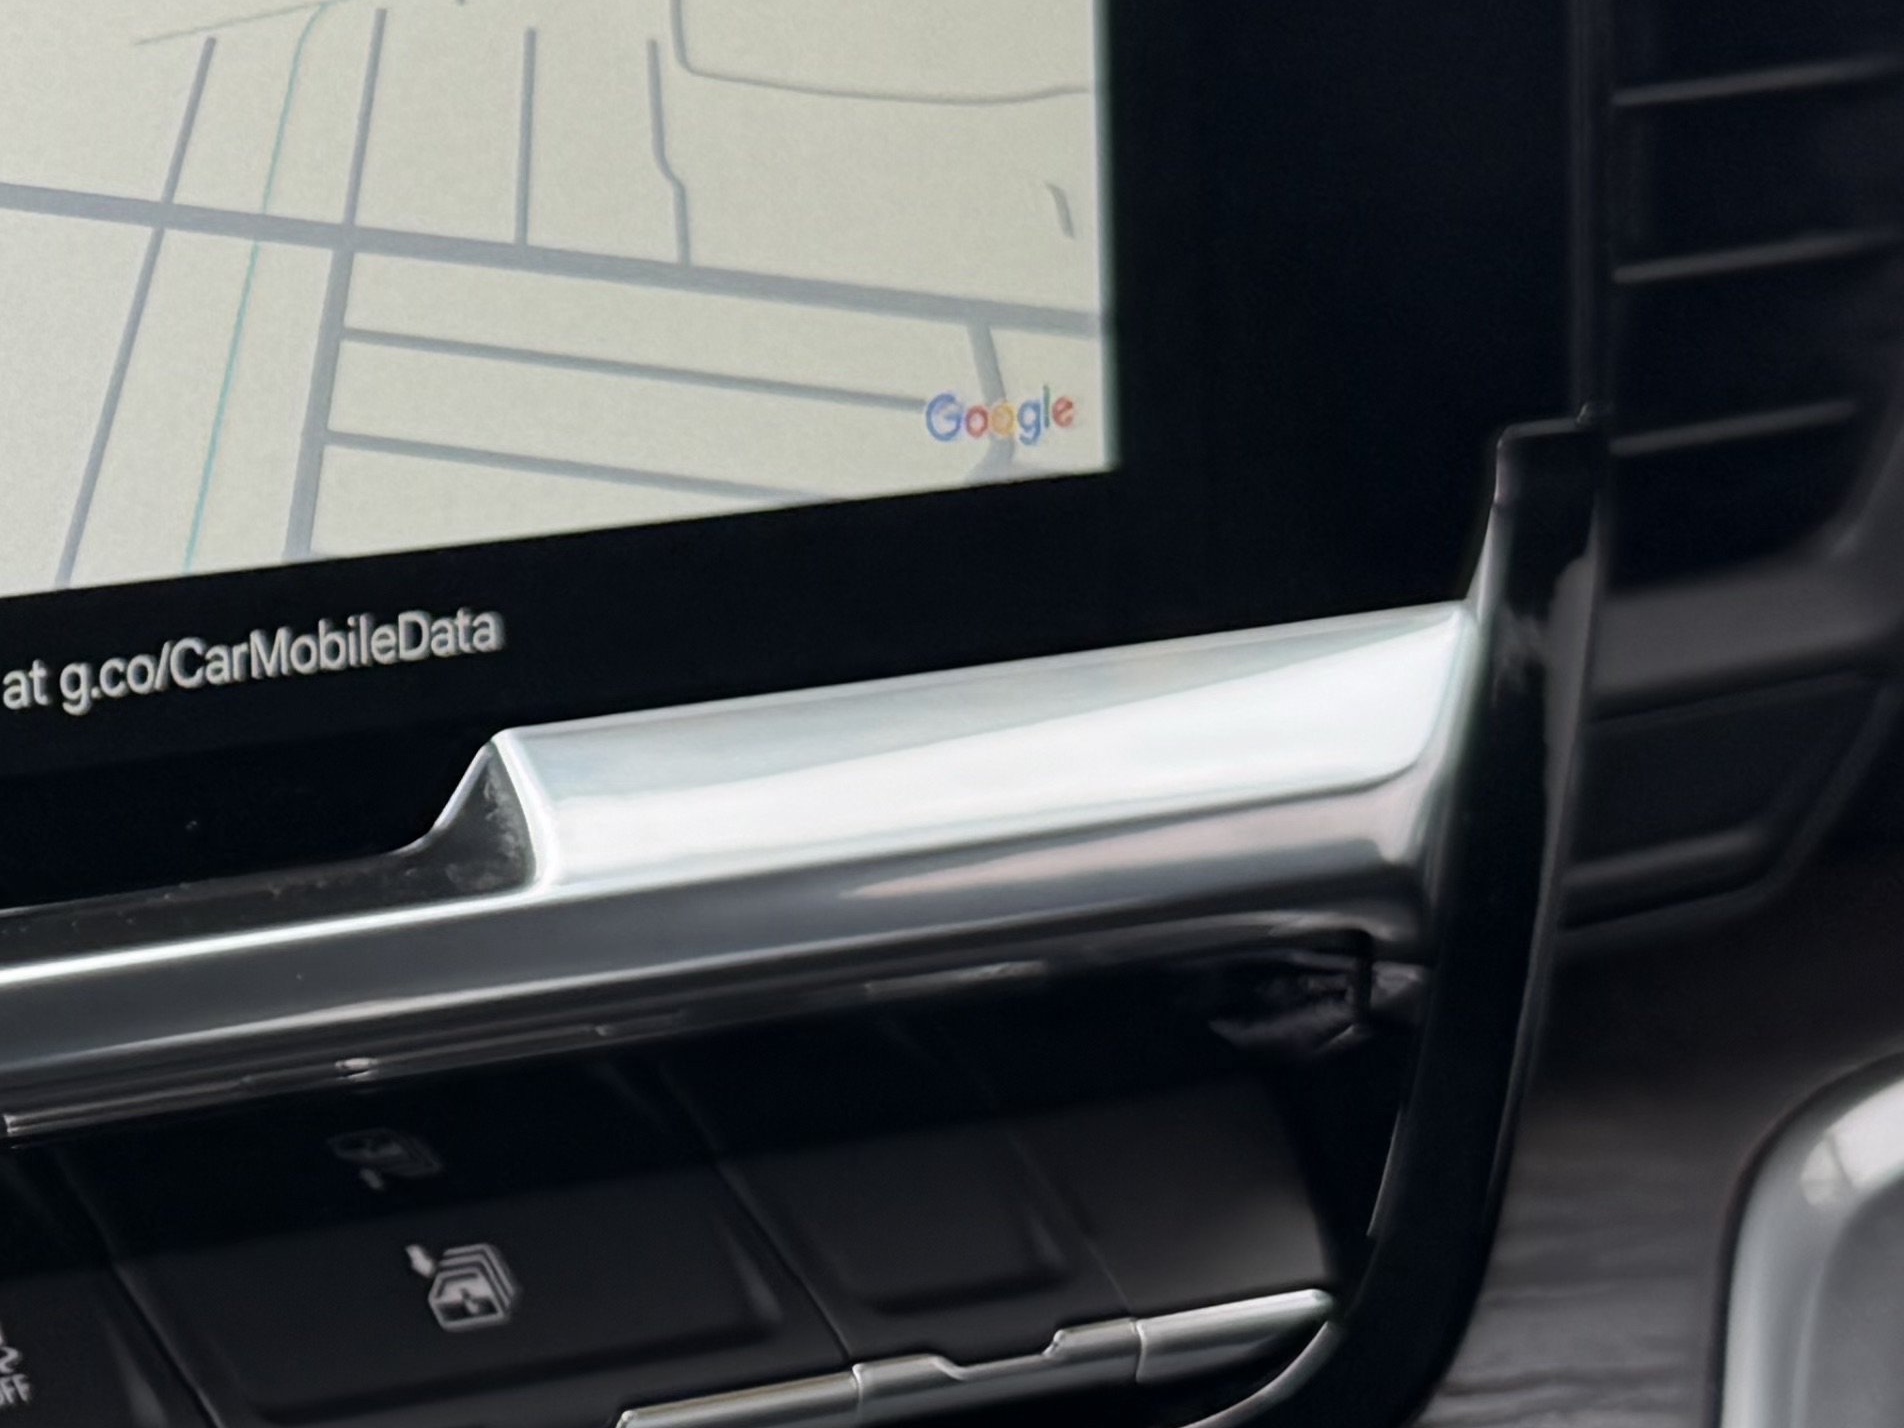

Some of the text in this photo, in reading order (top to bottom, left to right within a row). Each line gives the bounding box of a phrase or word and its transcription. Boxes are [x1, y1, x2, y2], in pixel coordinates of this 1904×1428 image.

[923, 383, 1076, 446] Google
[2, 659, 49, 710] at
[58, 608, 500, 716] g.co/CarMobileData
